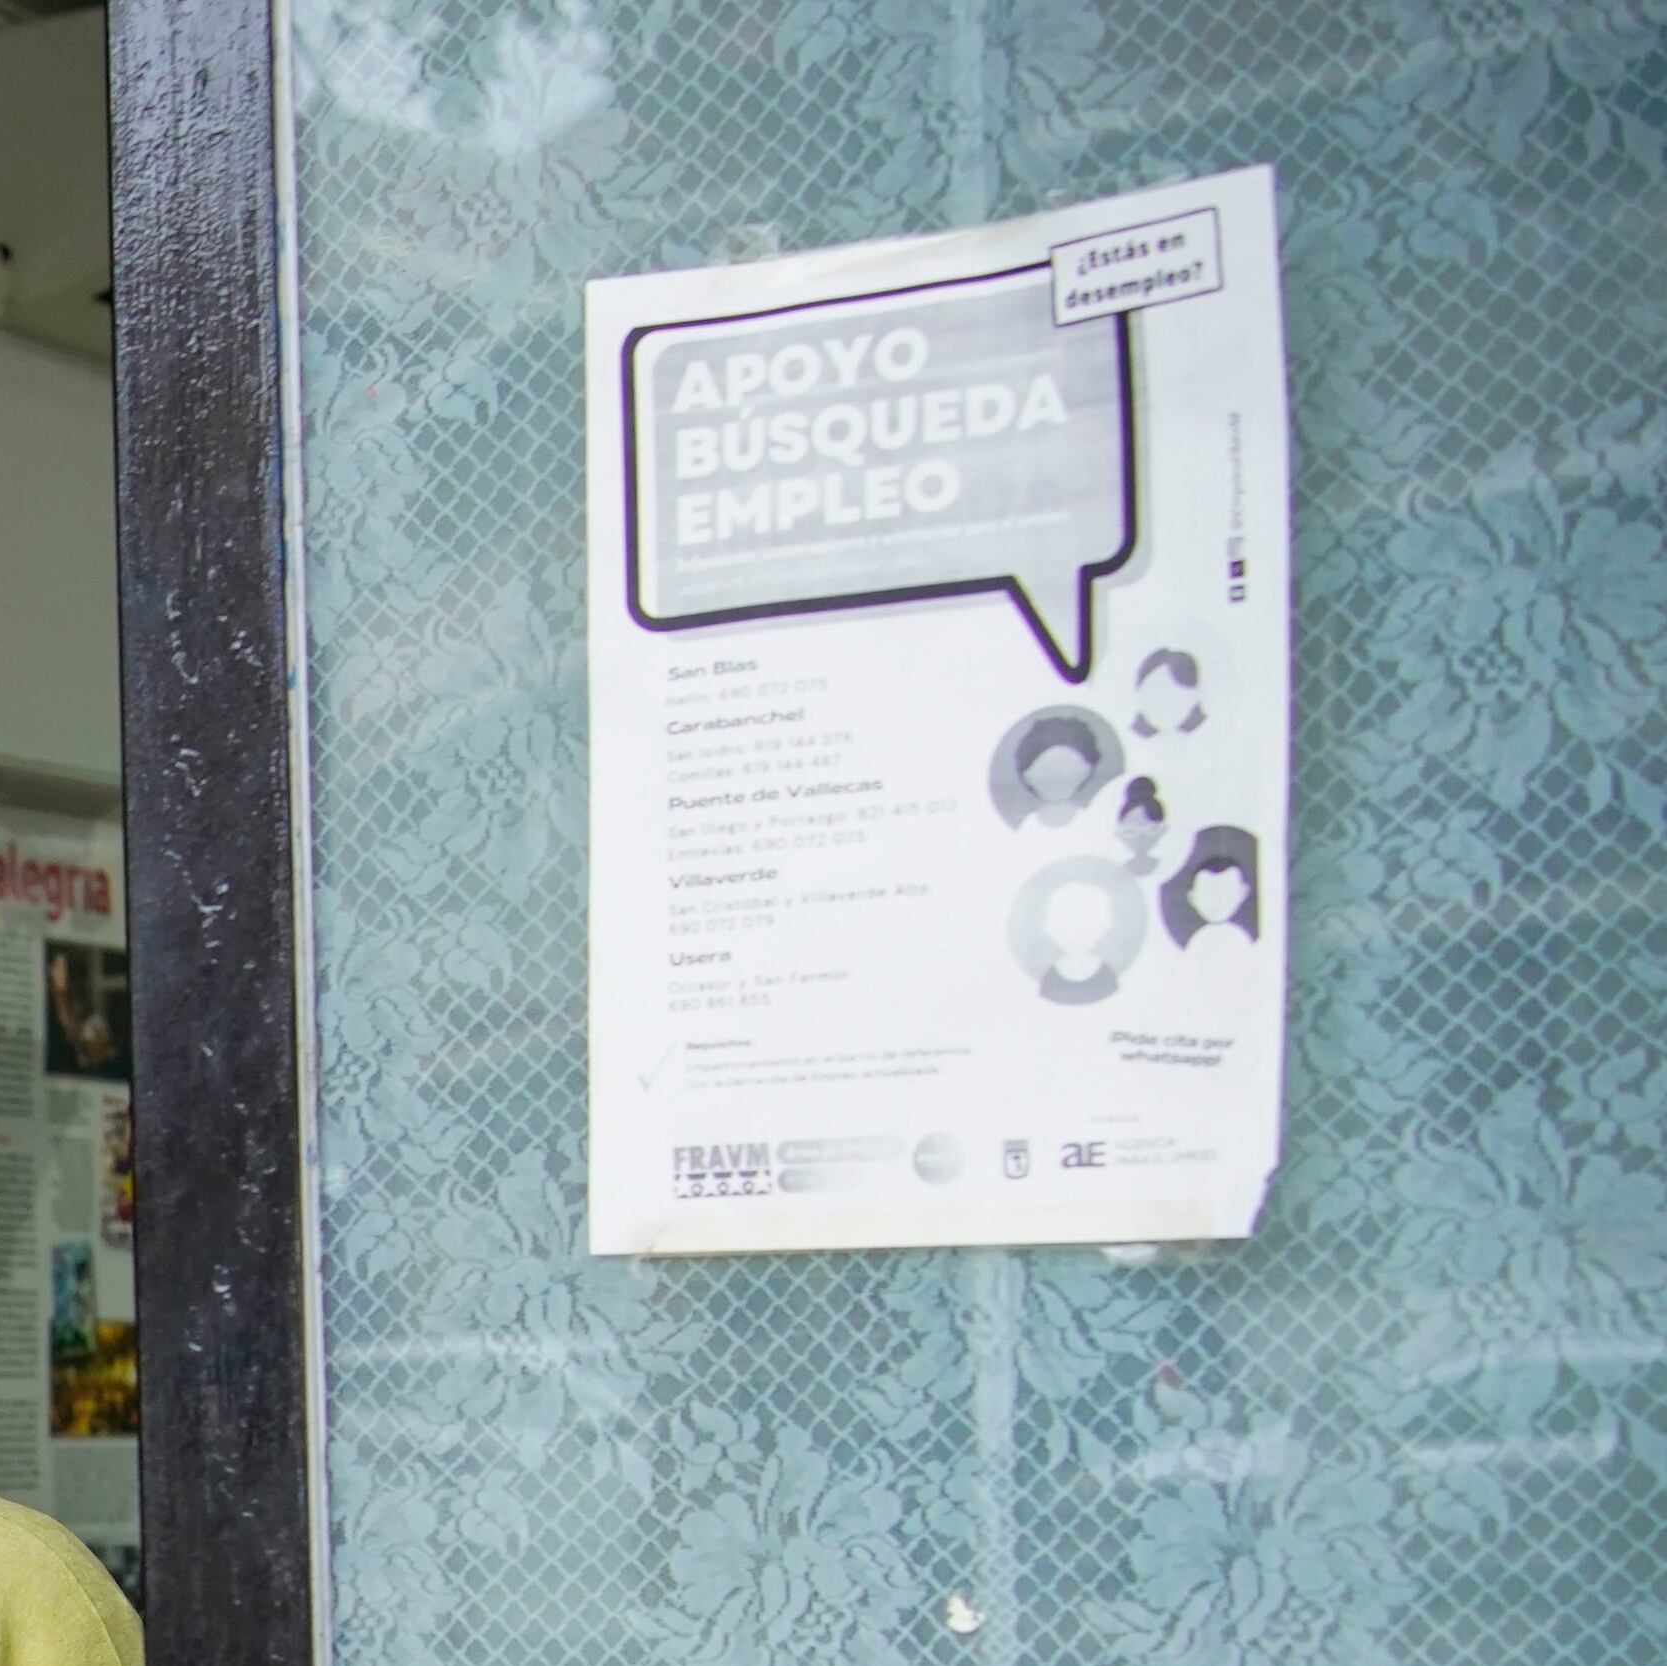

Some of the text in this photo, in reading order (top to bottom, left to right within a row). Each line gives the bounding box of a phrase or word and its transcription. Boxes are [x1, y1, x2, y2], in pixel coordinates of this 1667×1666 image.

[1157, 231, 1185, 252] en
[1065, 259, 1204, 309] desempleo?
[671, 327, 929, 414] APOYO
[676, 374, 1069, 479] BÚSQUEDA
[676, 459, 961, 546] EMPLEO
[668, 659, 759, 682] San Blas
[666, 706, 805, 736] Carabanchel
[668, 778, 885, 811] Puente de Vallecas
[668, 868, 779, 890] Villaverde
[668, 950, 733, 967] Usera
[673, 1142, 770, 1171] FRAVM
